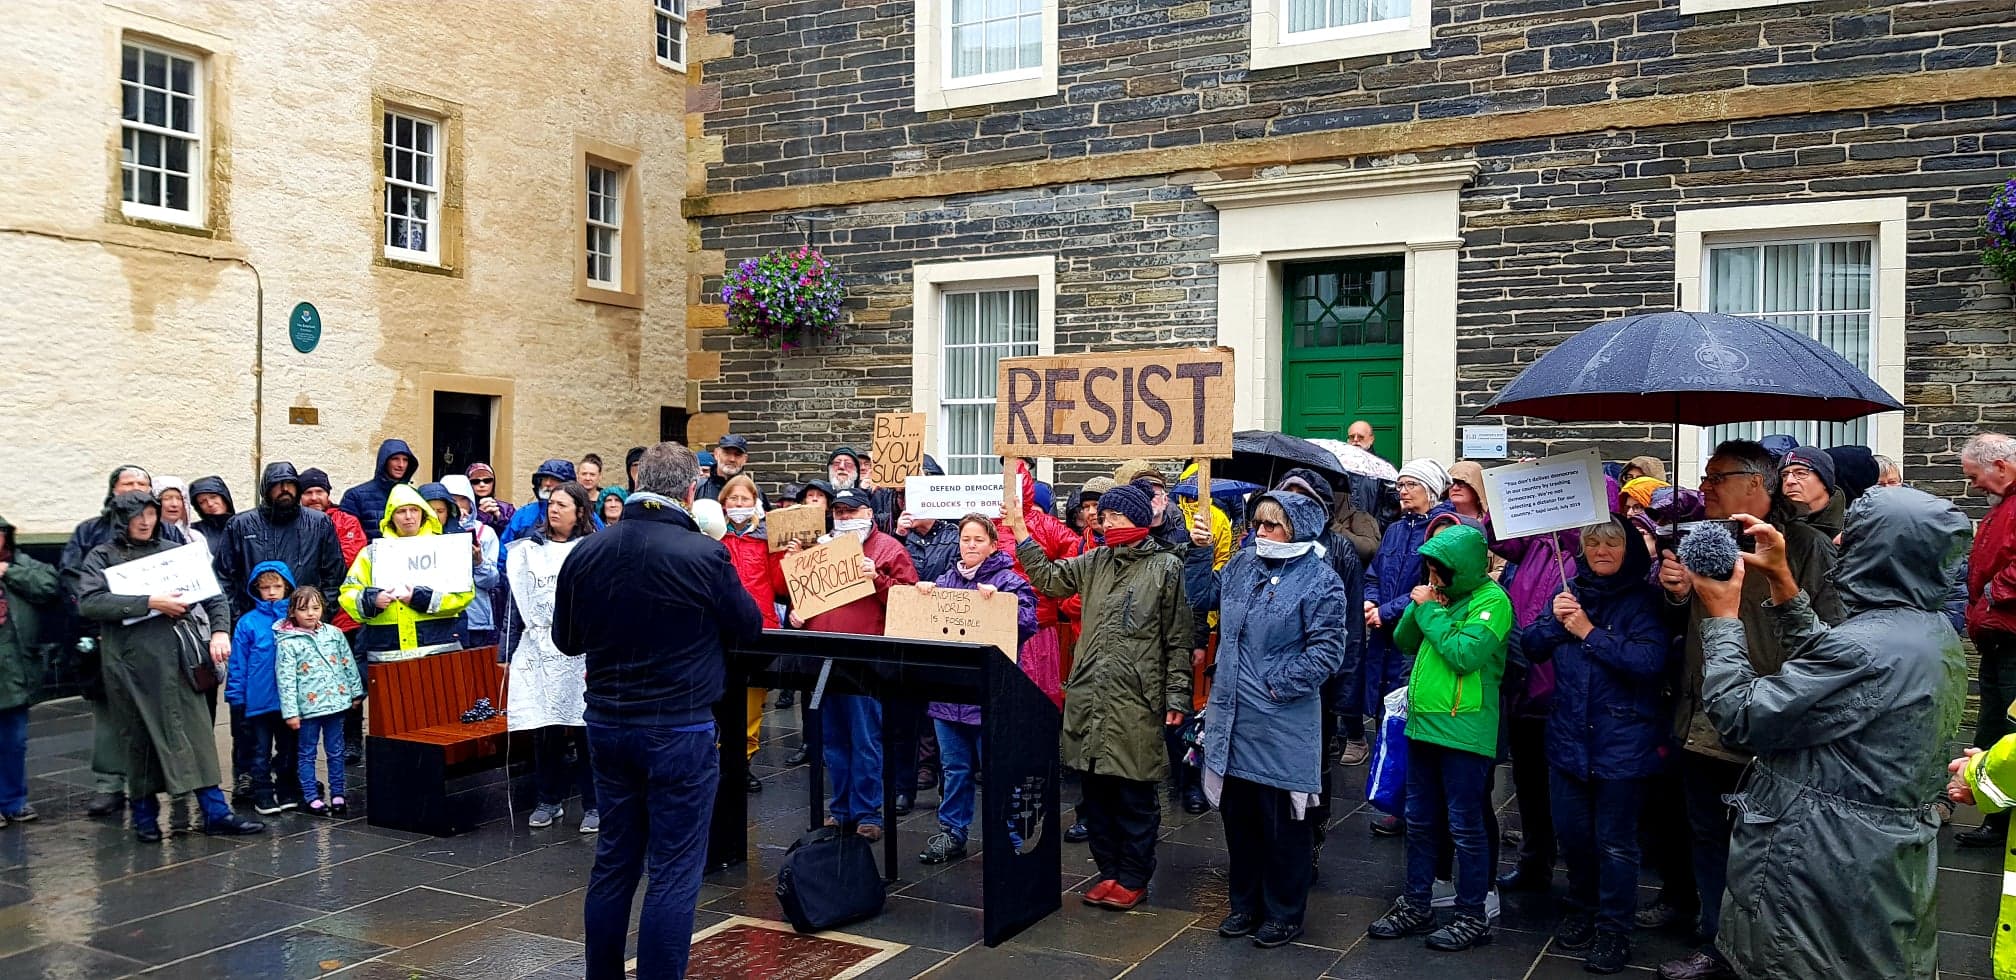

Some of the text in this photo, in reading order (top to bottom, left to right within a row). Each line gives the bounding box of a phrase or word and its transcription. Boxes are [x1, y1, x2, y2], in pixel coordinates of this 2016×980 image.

[1680, 376, 1781, 388] VAUALL
[1006, 361, 1223, 445] RESIST
[872, 440, 921, 464] YOU
[1551, 470, 1579, 479] democracy
[965, 484, 1005, 492] DEMOCRA
[1509, 503, 1532, 511] selecting
[1537, 498, 1557, 506] dictator
[407, 551, 437, 571] NO!
[795, 547, 829, 572] PURE
[931, 590, 971, 602] ANOTHER
[937, 602, 971, 614] WORLD
[930, 614, 938, 624] IS
